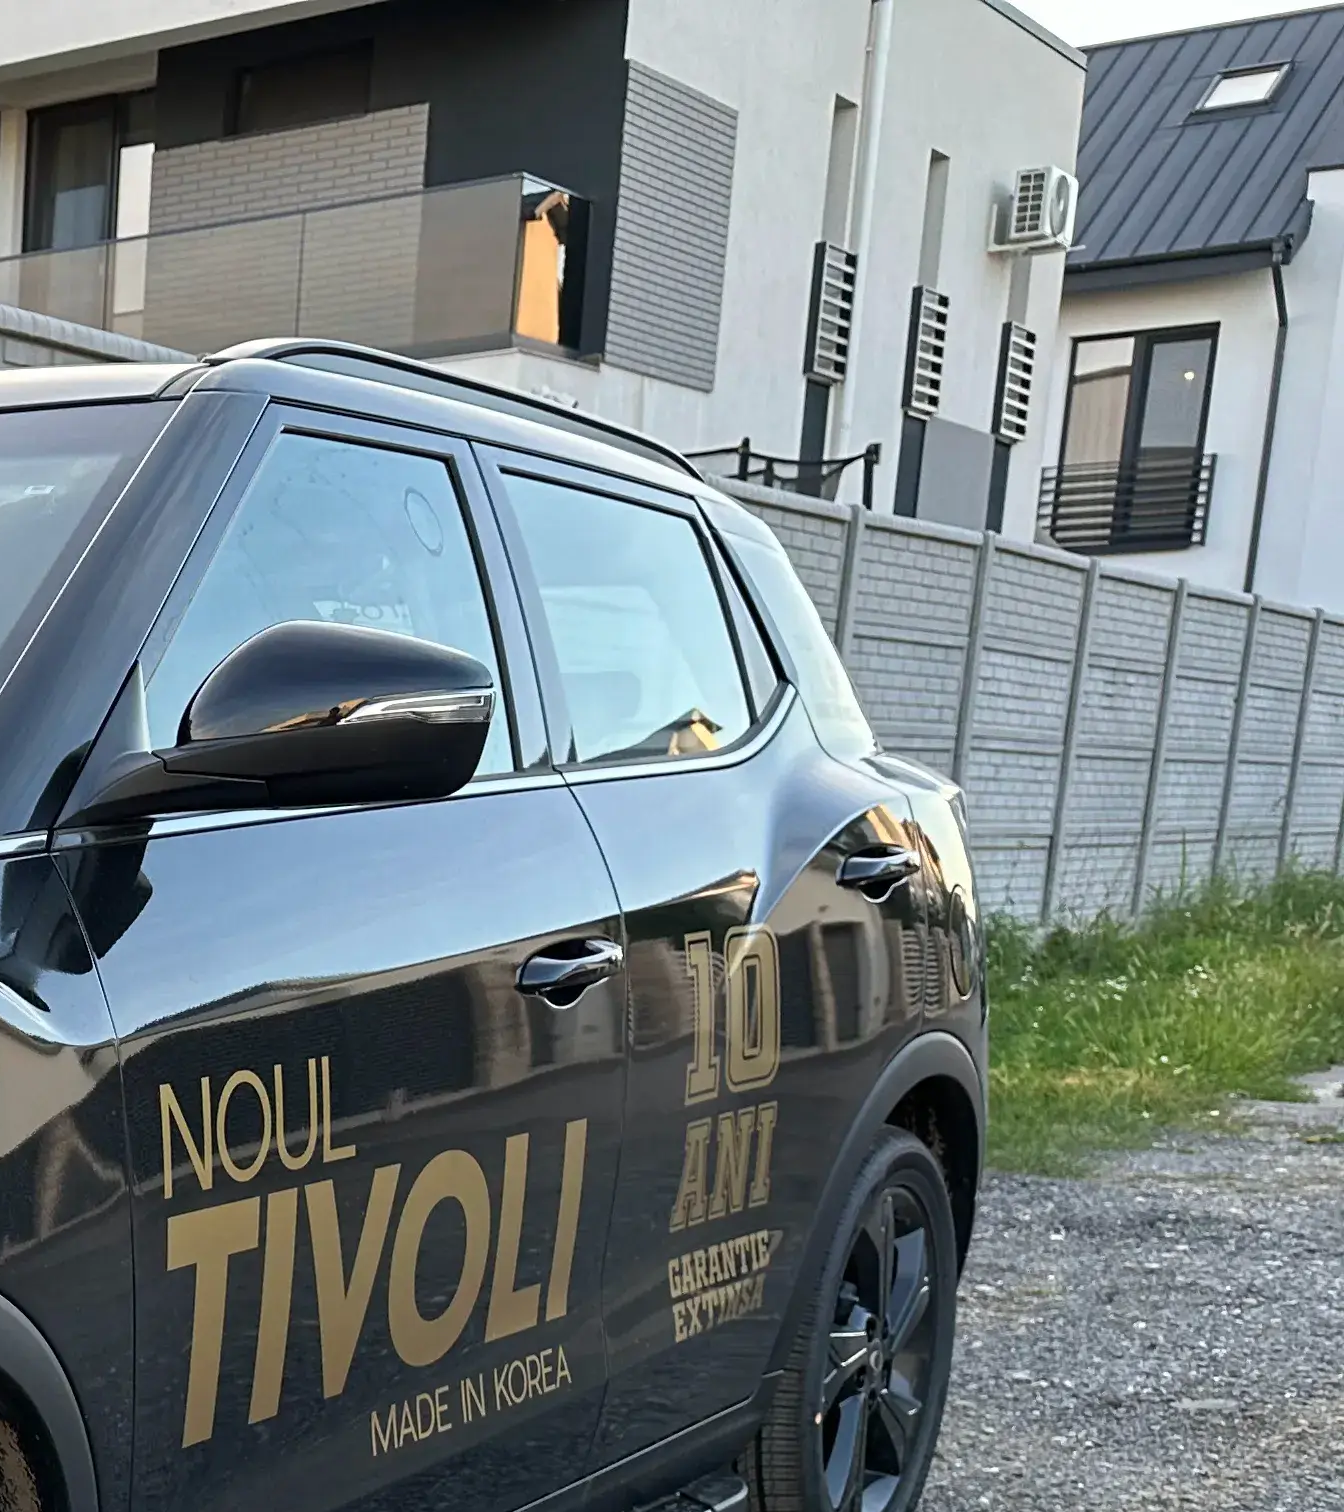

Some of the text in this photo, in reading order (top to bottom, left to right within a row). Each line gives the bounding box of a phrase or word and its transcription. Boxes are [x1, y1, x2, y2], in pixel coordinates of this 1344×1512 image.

[683, 923, 781, 1107] 10
[158, 1055, 357, 1200] NOUL
[668, 1100, 778, 1234] ANI
[166, 1117, 589, 1449] TIVOLI
[668, 1228, 771, 1299] GARANTIE
[370, 1343, 573, 1457] MADE IN KOREA
